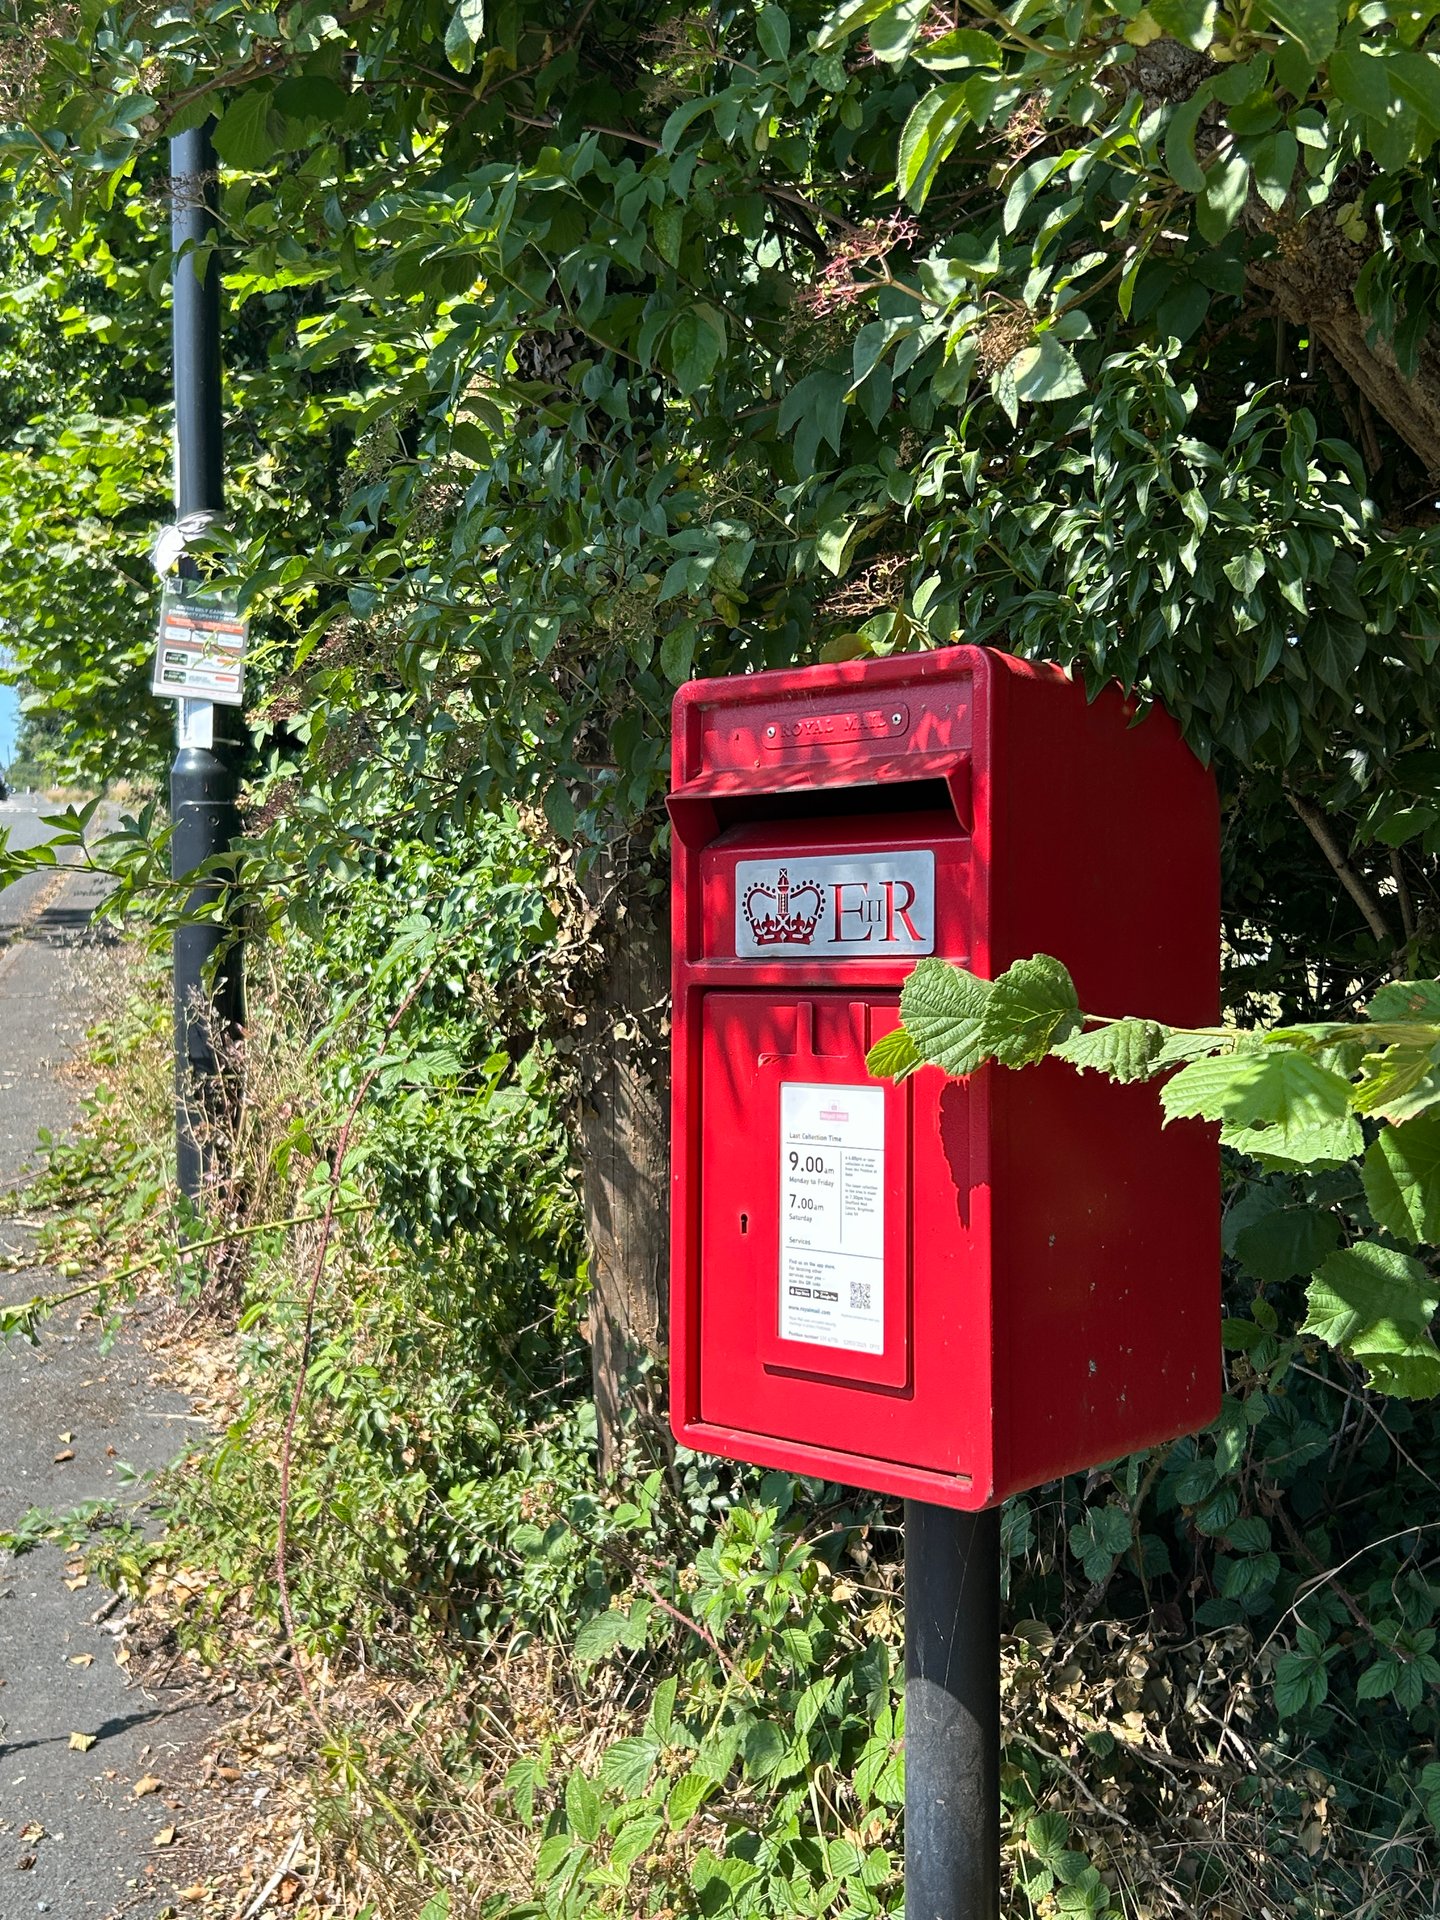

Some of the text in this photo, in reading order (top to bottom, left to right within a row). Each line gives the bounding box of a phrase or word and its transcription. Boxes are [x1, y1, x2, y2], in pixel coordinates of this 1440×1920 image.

[781, 713, 887, 738] ROYAL MAIL
[801, 1133, 828, 1141] Collection
[789, 1176, 809, 1185] Monday
[817, 1179, 834, 1188] Friday
[789, 1213, 812, 1223] Saturday
[789, 1236, 811, 1246] Services
